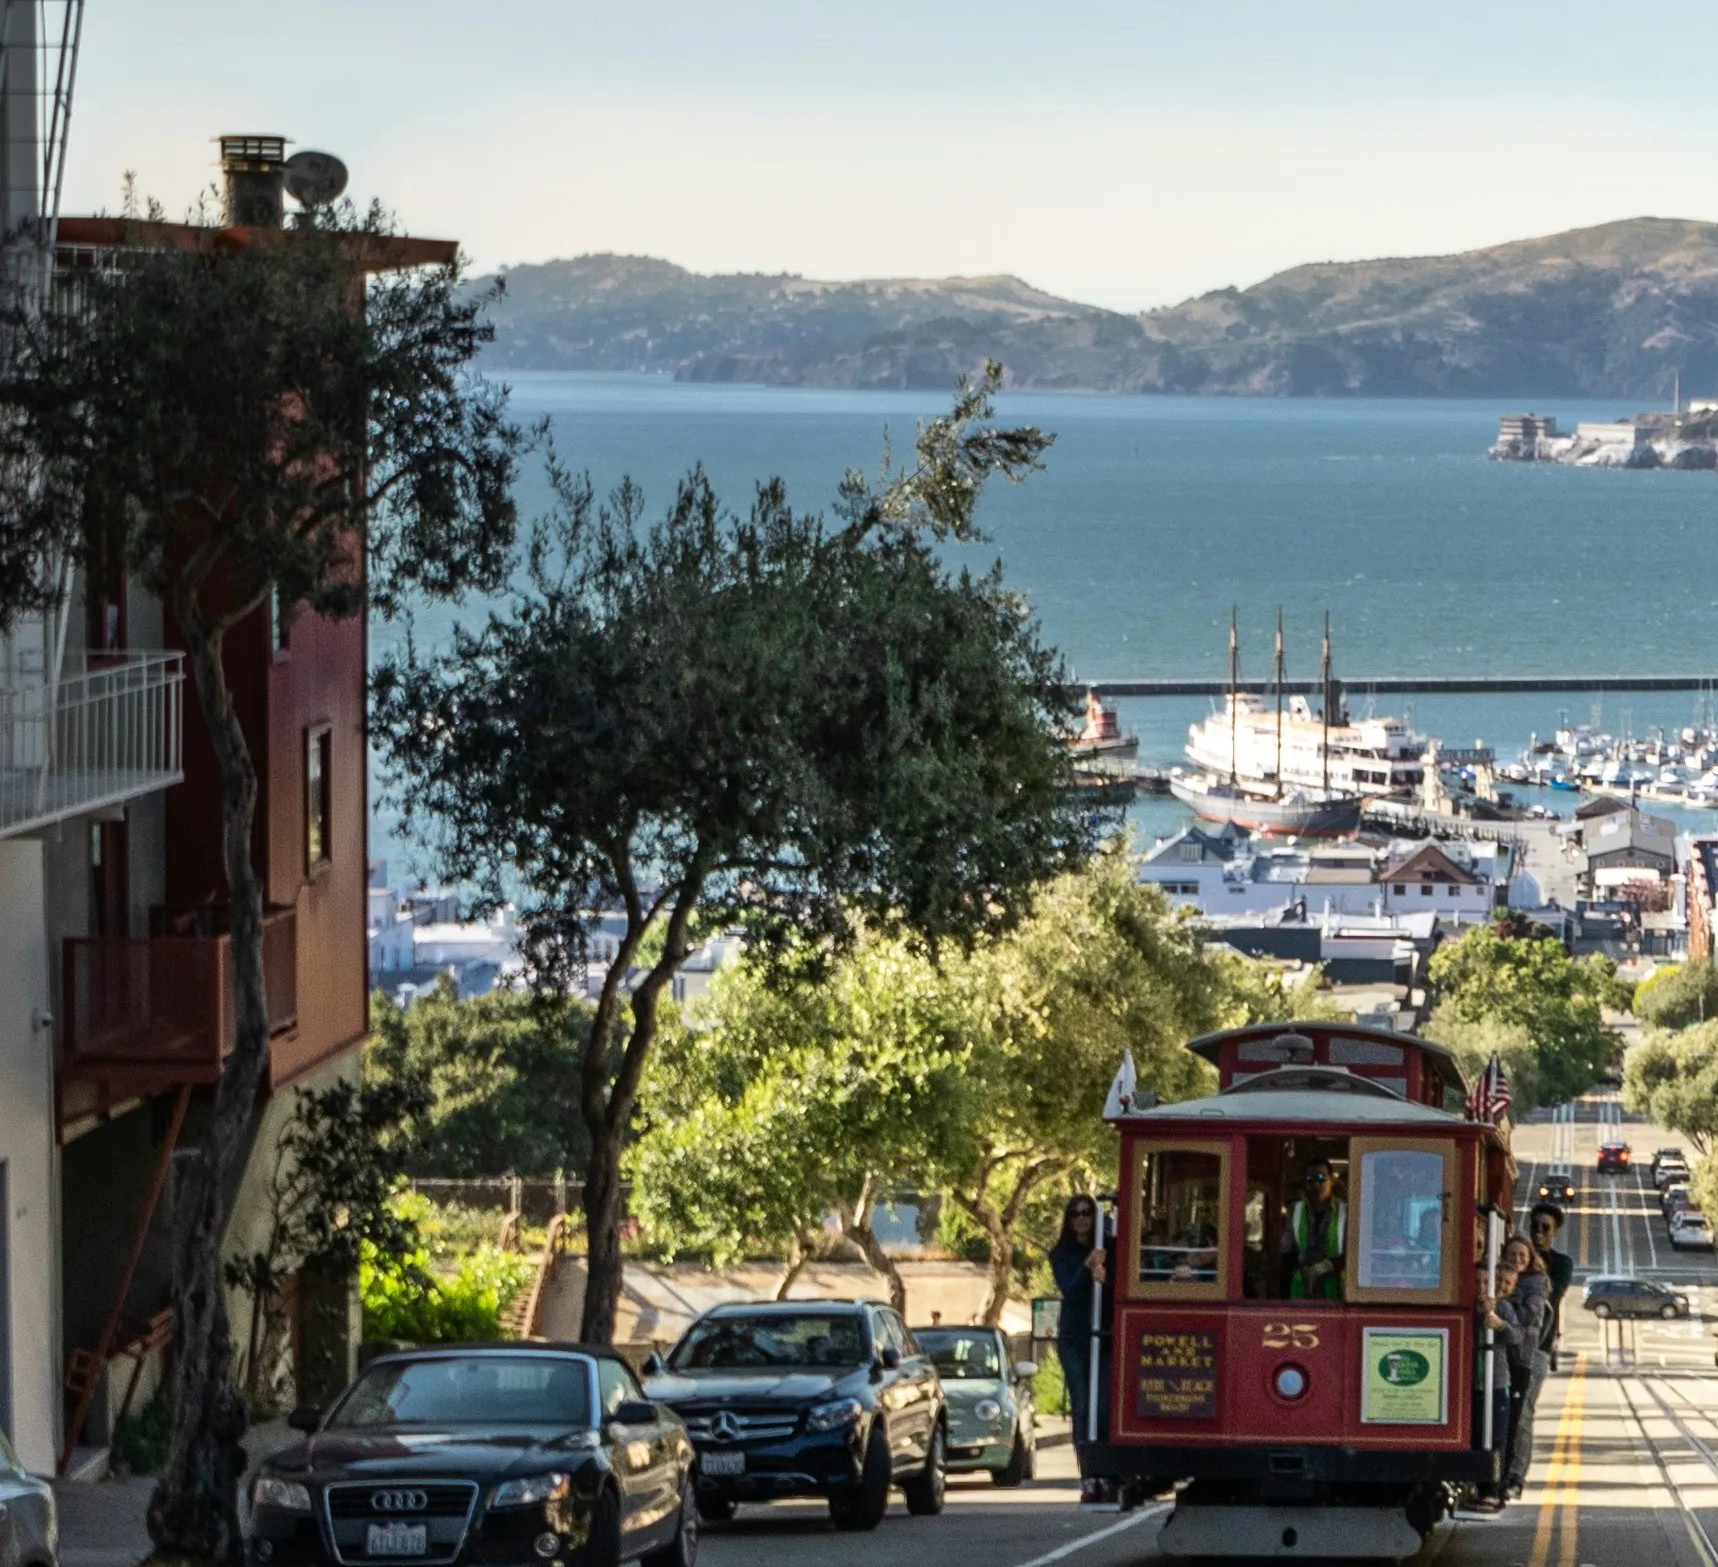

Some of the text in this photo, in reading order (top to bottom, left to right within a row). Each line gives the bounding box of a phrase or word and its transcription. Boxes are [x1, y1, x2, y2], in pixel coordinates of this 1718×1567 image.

[1143, 1335, 1213, 1347] POWELL
[1263, 1323, 1320, 1349] 25
[1140, 1355, 1213, 1368] MARKET
